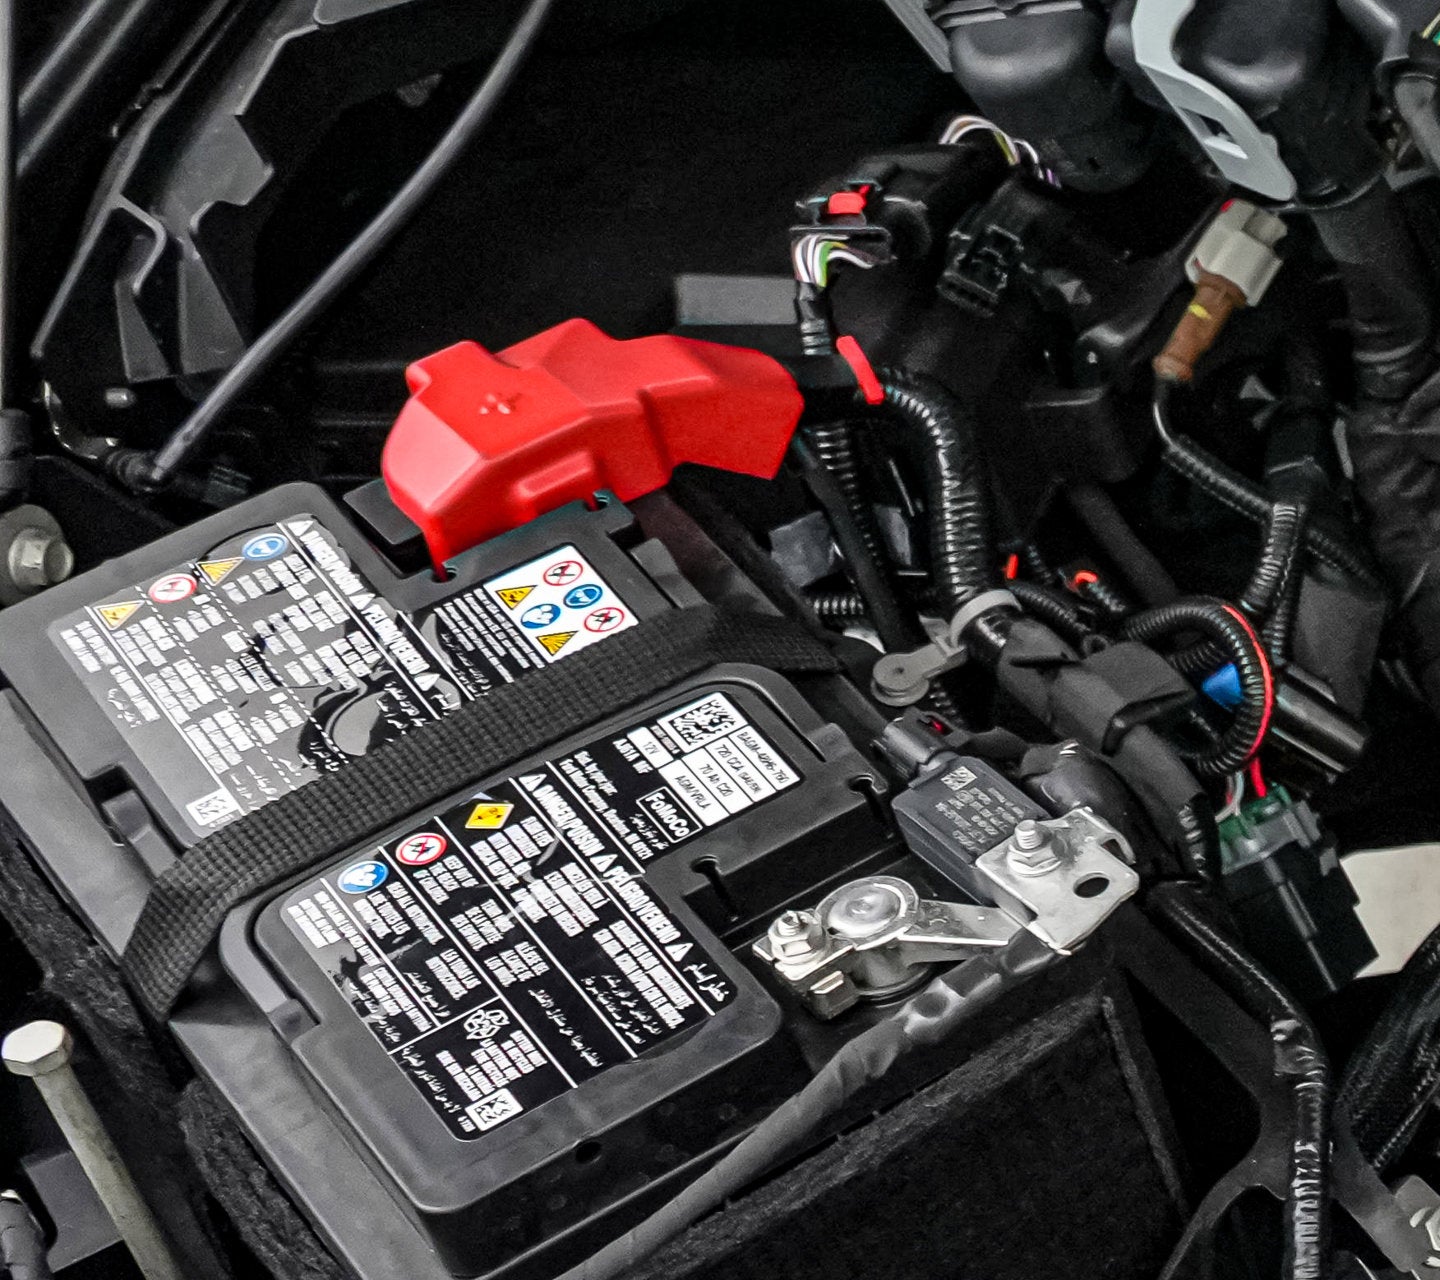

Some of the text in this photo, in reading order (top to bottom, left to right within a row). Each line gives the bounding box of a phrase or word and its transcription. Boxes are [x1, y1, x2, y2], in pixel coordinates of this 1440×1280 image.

[358, 603, 431, 676] PELIGRO/VENENO
[641, 740, 660, 756] 12V
[674, 773, 711, 810] AGM/VRLA
[529, 782, 606, 858] DANGER/POISON
[644, 791, 693, 839] FoMoCo
[452, 866, 472, 882] OUT
[396, 893, 415, 908] ALL
[600, 864, 681, 946] PELIGRO/VENENO
